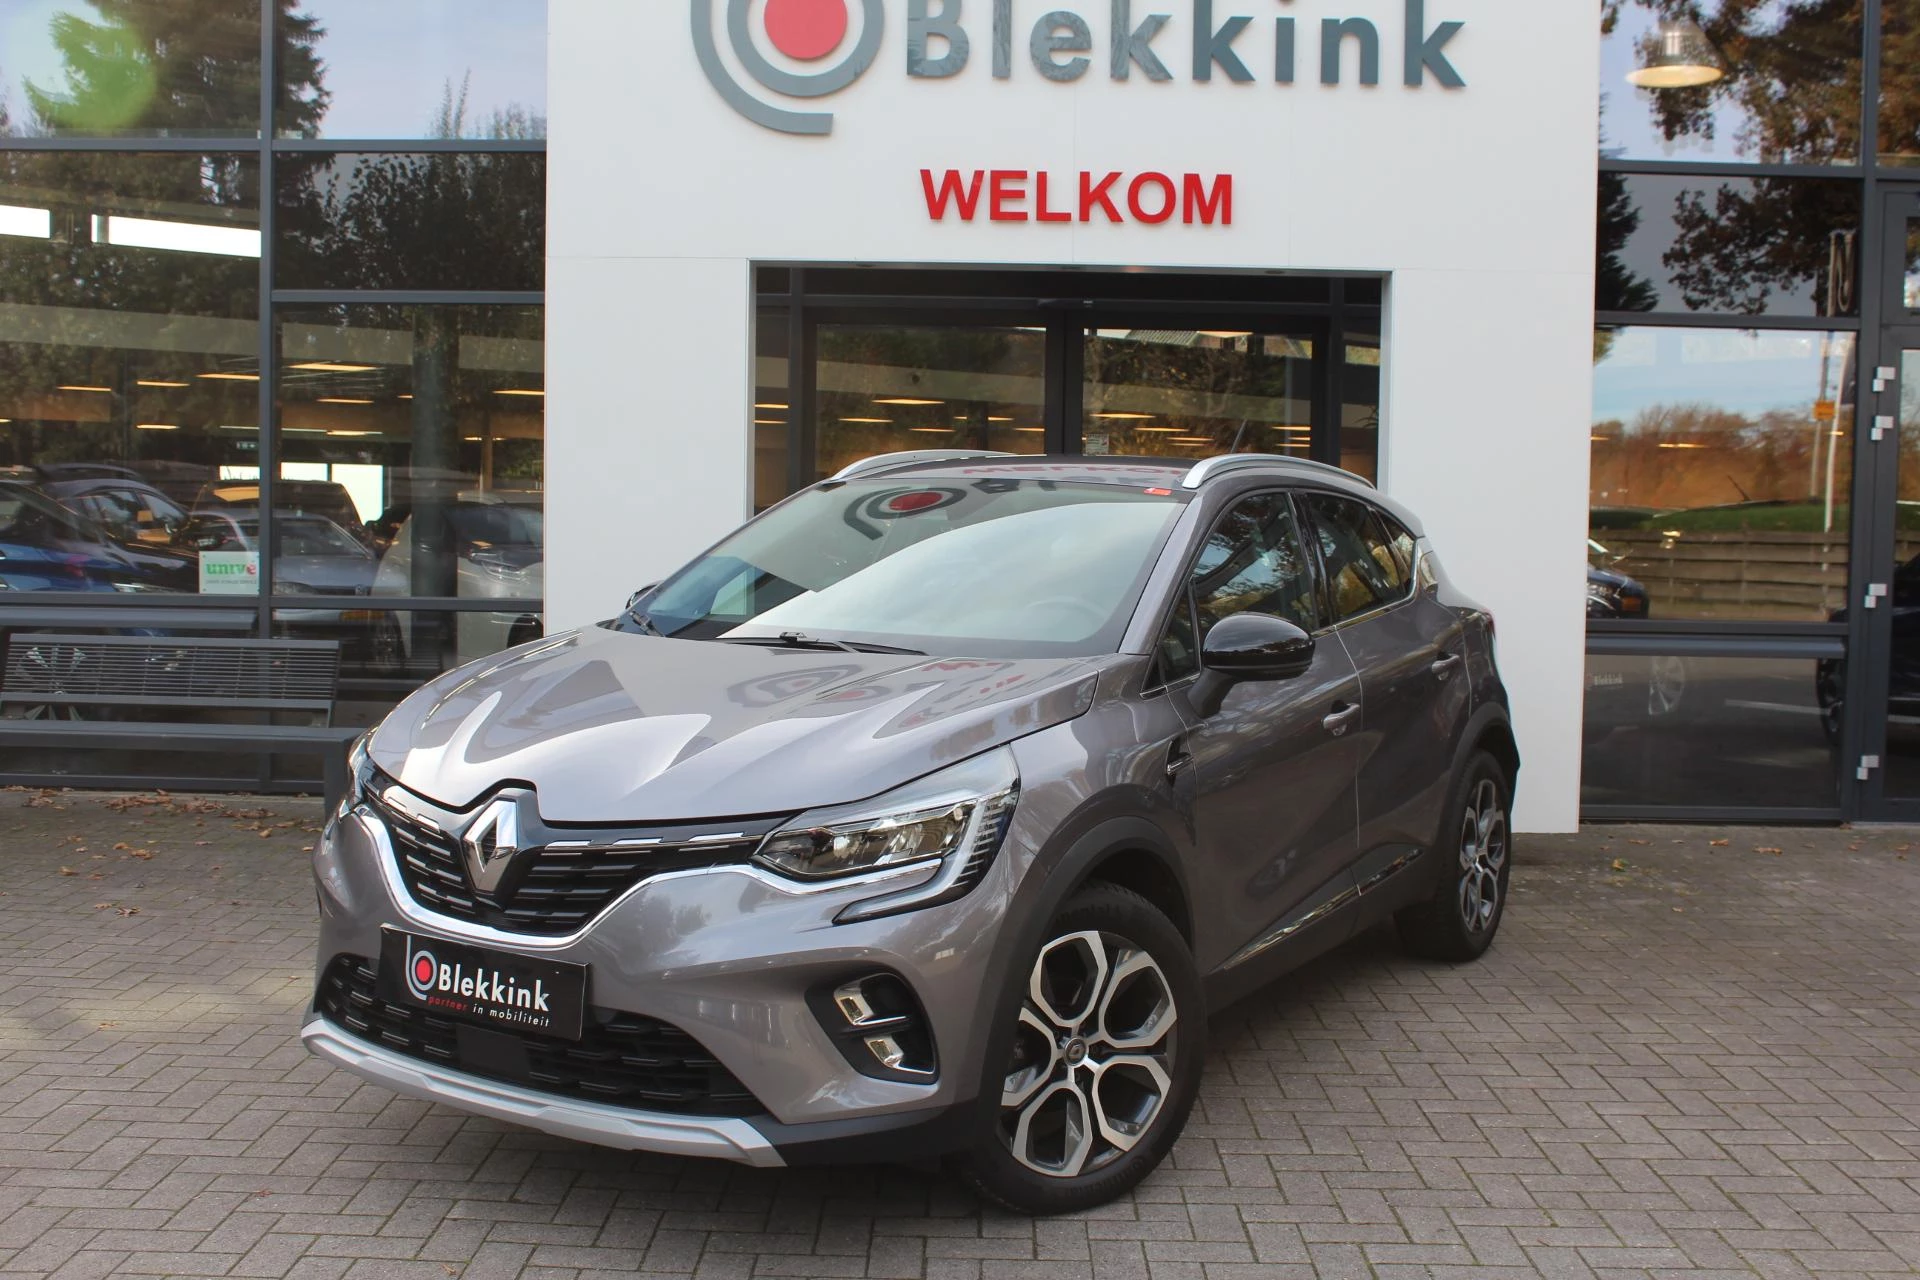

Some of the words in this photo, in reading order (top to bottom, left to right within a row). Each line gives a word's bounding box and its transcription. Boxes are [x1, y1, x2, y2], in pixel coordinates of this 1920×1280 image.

[906, 0, 1467, 88] Blekkink
[920, 169, 1234, 226] WELKOM
[428, 995, 468, 1012] partner
[472, 1003, 484, 1015] in
[489, 1008, 550, 1028] mobiliteit
[438, 963, 550, 1012] Blekkink
